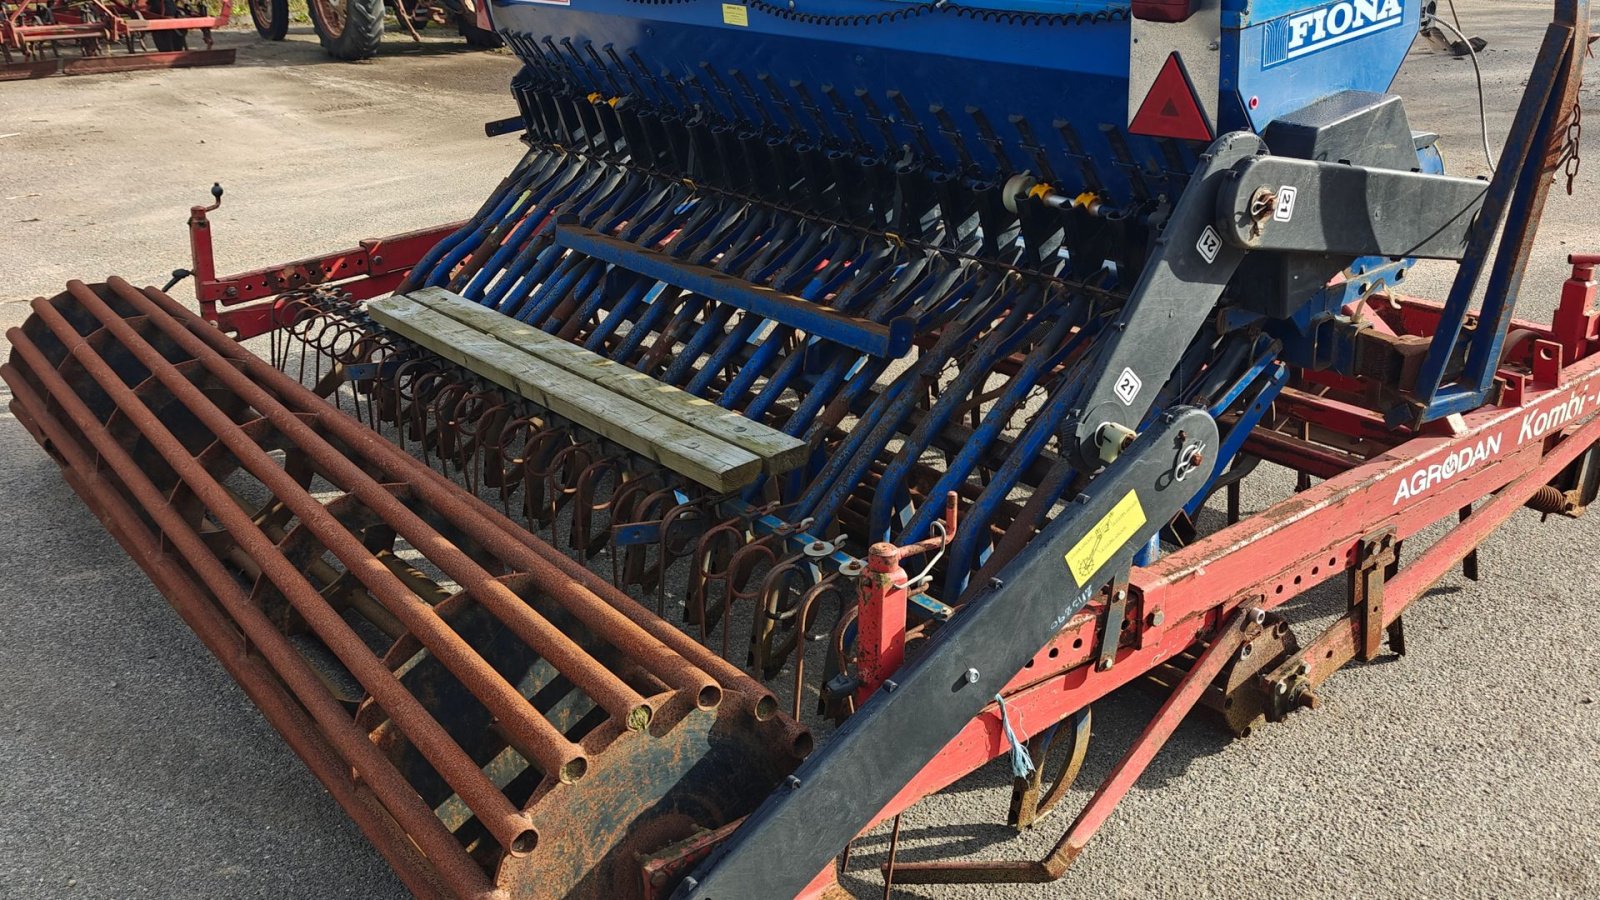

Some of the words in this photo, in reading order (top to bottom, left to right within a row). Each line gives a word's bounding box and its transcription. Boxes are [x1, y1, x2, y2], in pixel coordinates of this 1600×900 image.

[1288, 0, 1402, 49] FIONA
[1280, 193, 1291, 213] 21
[1203, 235, 1217, 253] 21
[1120, 378, 1135, 396] 21
[1392, 432, 1502, 505] AGRODAN
[1517, 384, 1600, 445] Kombi-
